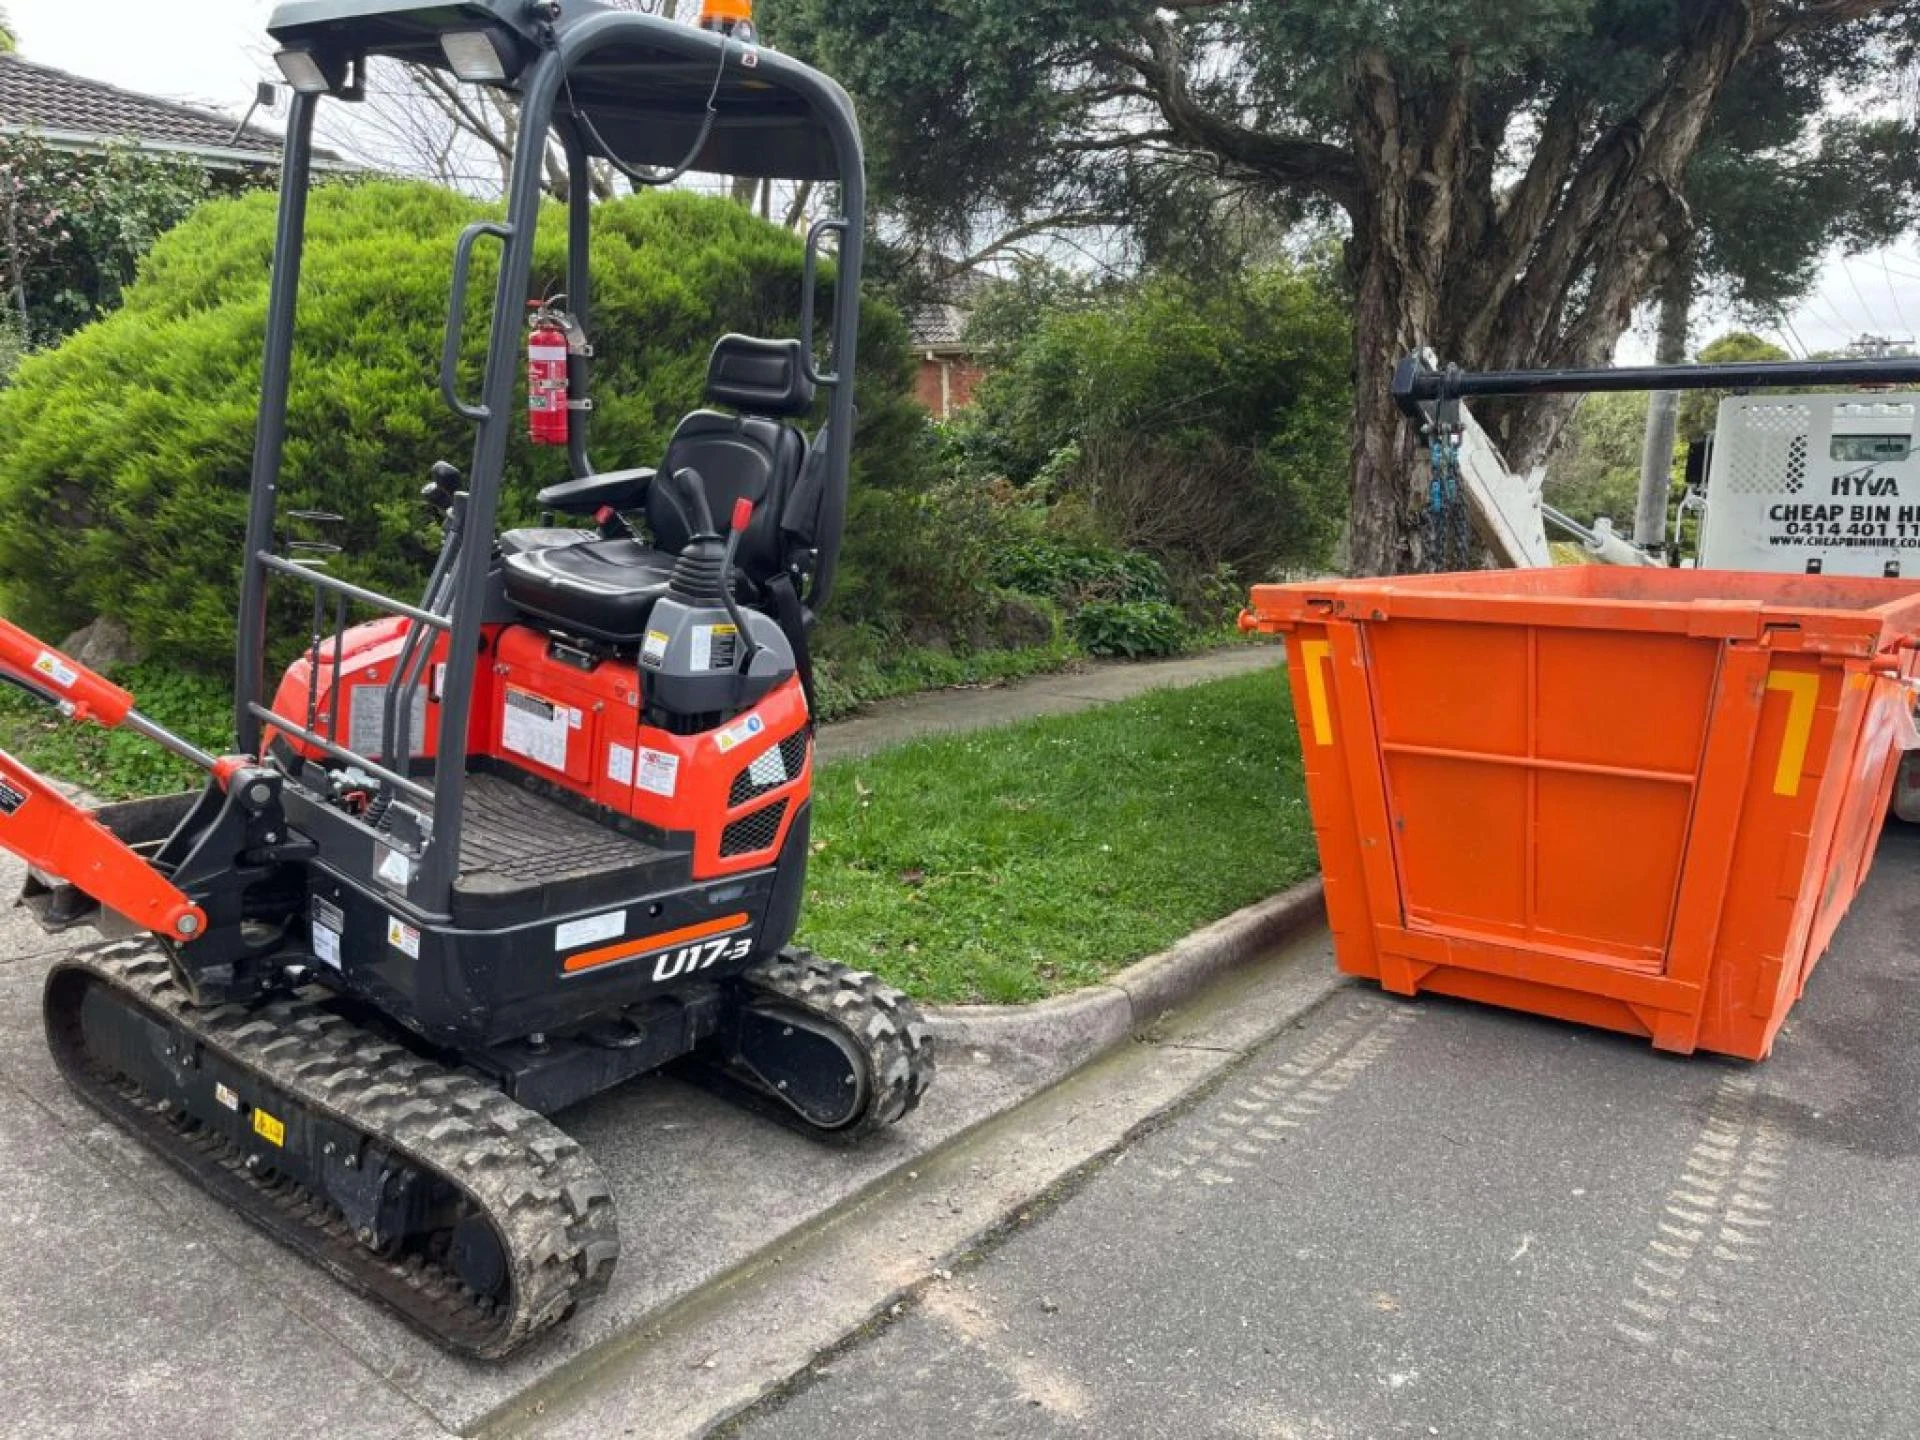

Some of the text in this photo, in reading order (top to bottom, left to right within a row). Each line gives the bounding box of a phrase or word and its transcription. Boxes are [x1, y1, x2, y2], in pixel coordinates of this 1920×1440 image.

[1832, 469, 1899, 496] HYVA
[1770, 504, 1843, 521] CHEAP
[1850, 505, 1890, 521] BIN
[1786, 523, 1840, 535] 0414
[1847, 523, 1886, 536] 401
[1769, 536, 1920, 548] WWW.CHEAPBINHIRE.CO
[653, 937, 752, 981] U17-3
